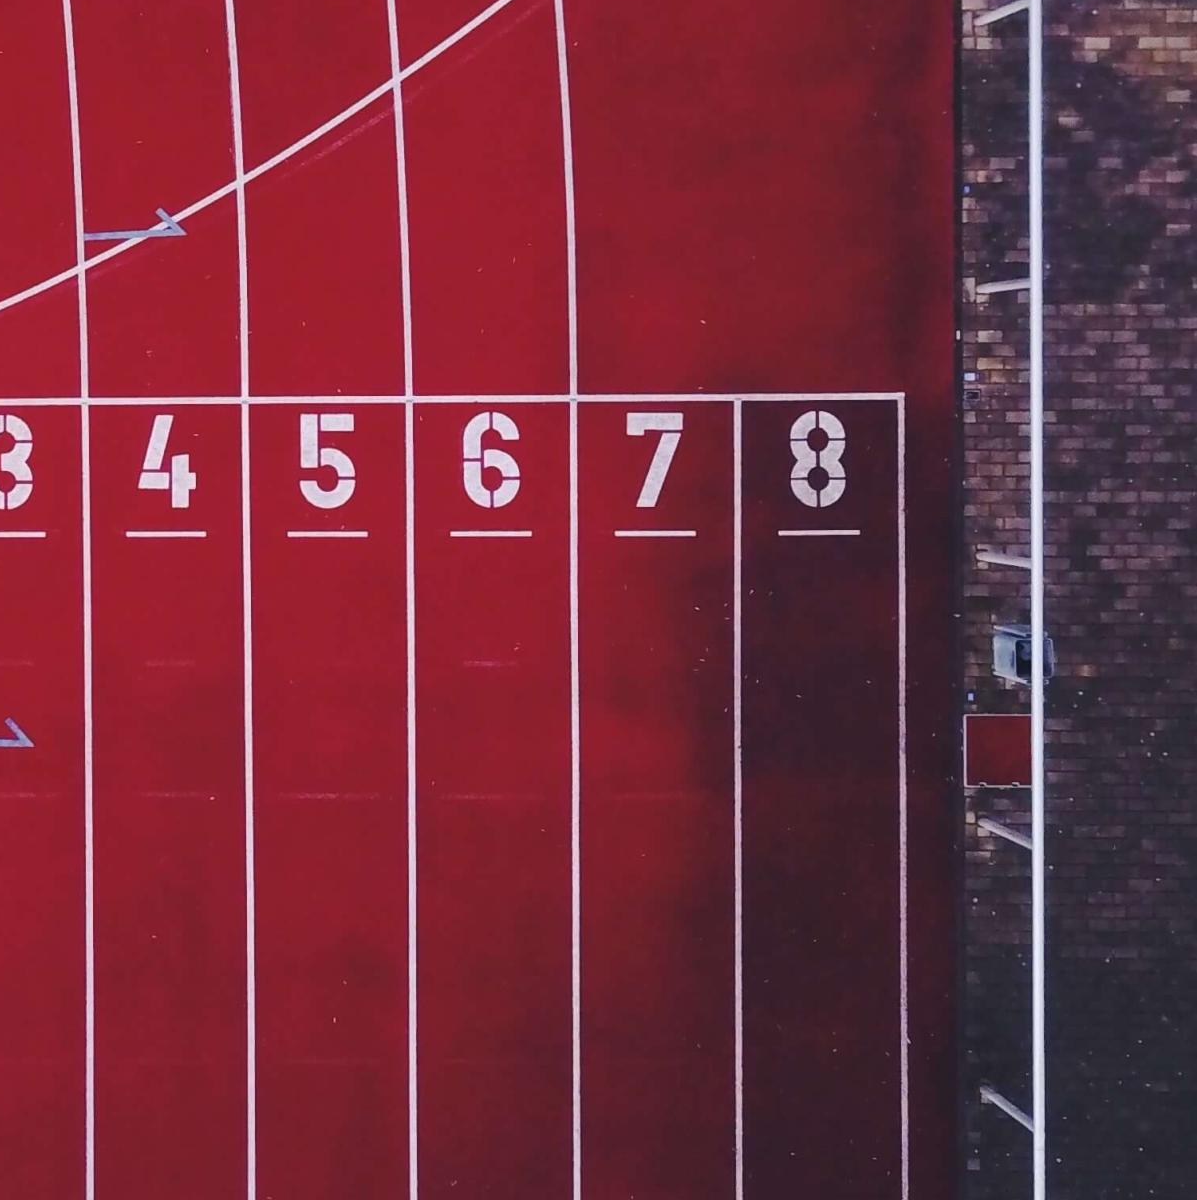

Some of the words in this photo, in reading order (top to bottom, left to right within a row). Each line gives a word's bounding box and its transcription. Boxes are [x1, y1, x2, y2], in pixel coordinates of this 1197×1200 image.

[138, 415, 196, 508] 4
[300, 414, 355, 509] 5
[463, 412, 520, 508] 6
[627, 413, 683, 507] 7
[790, 411, 846, 507] 8
